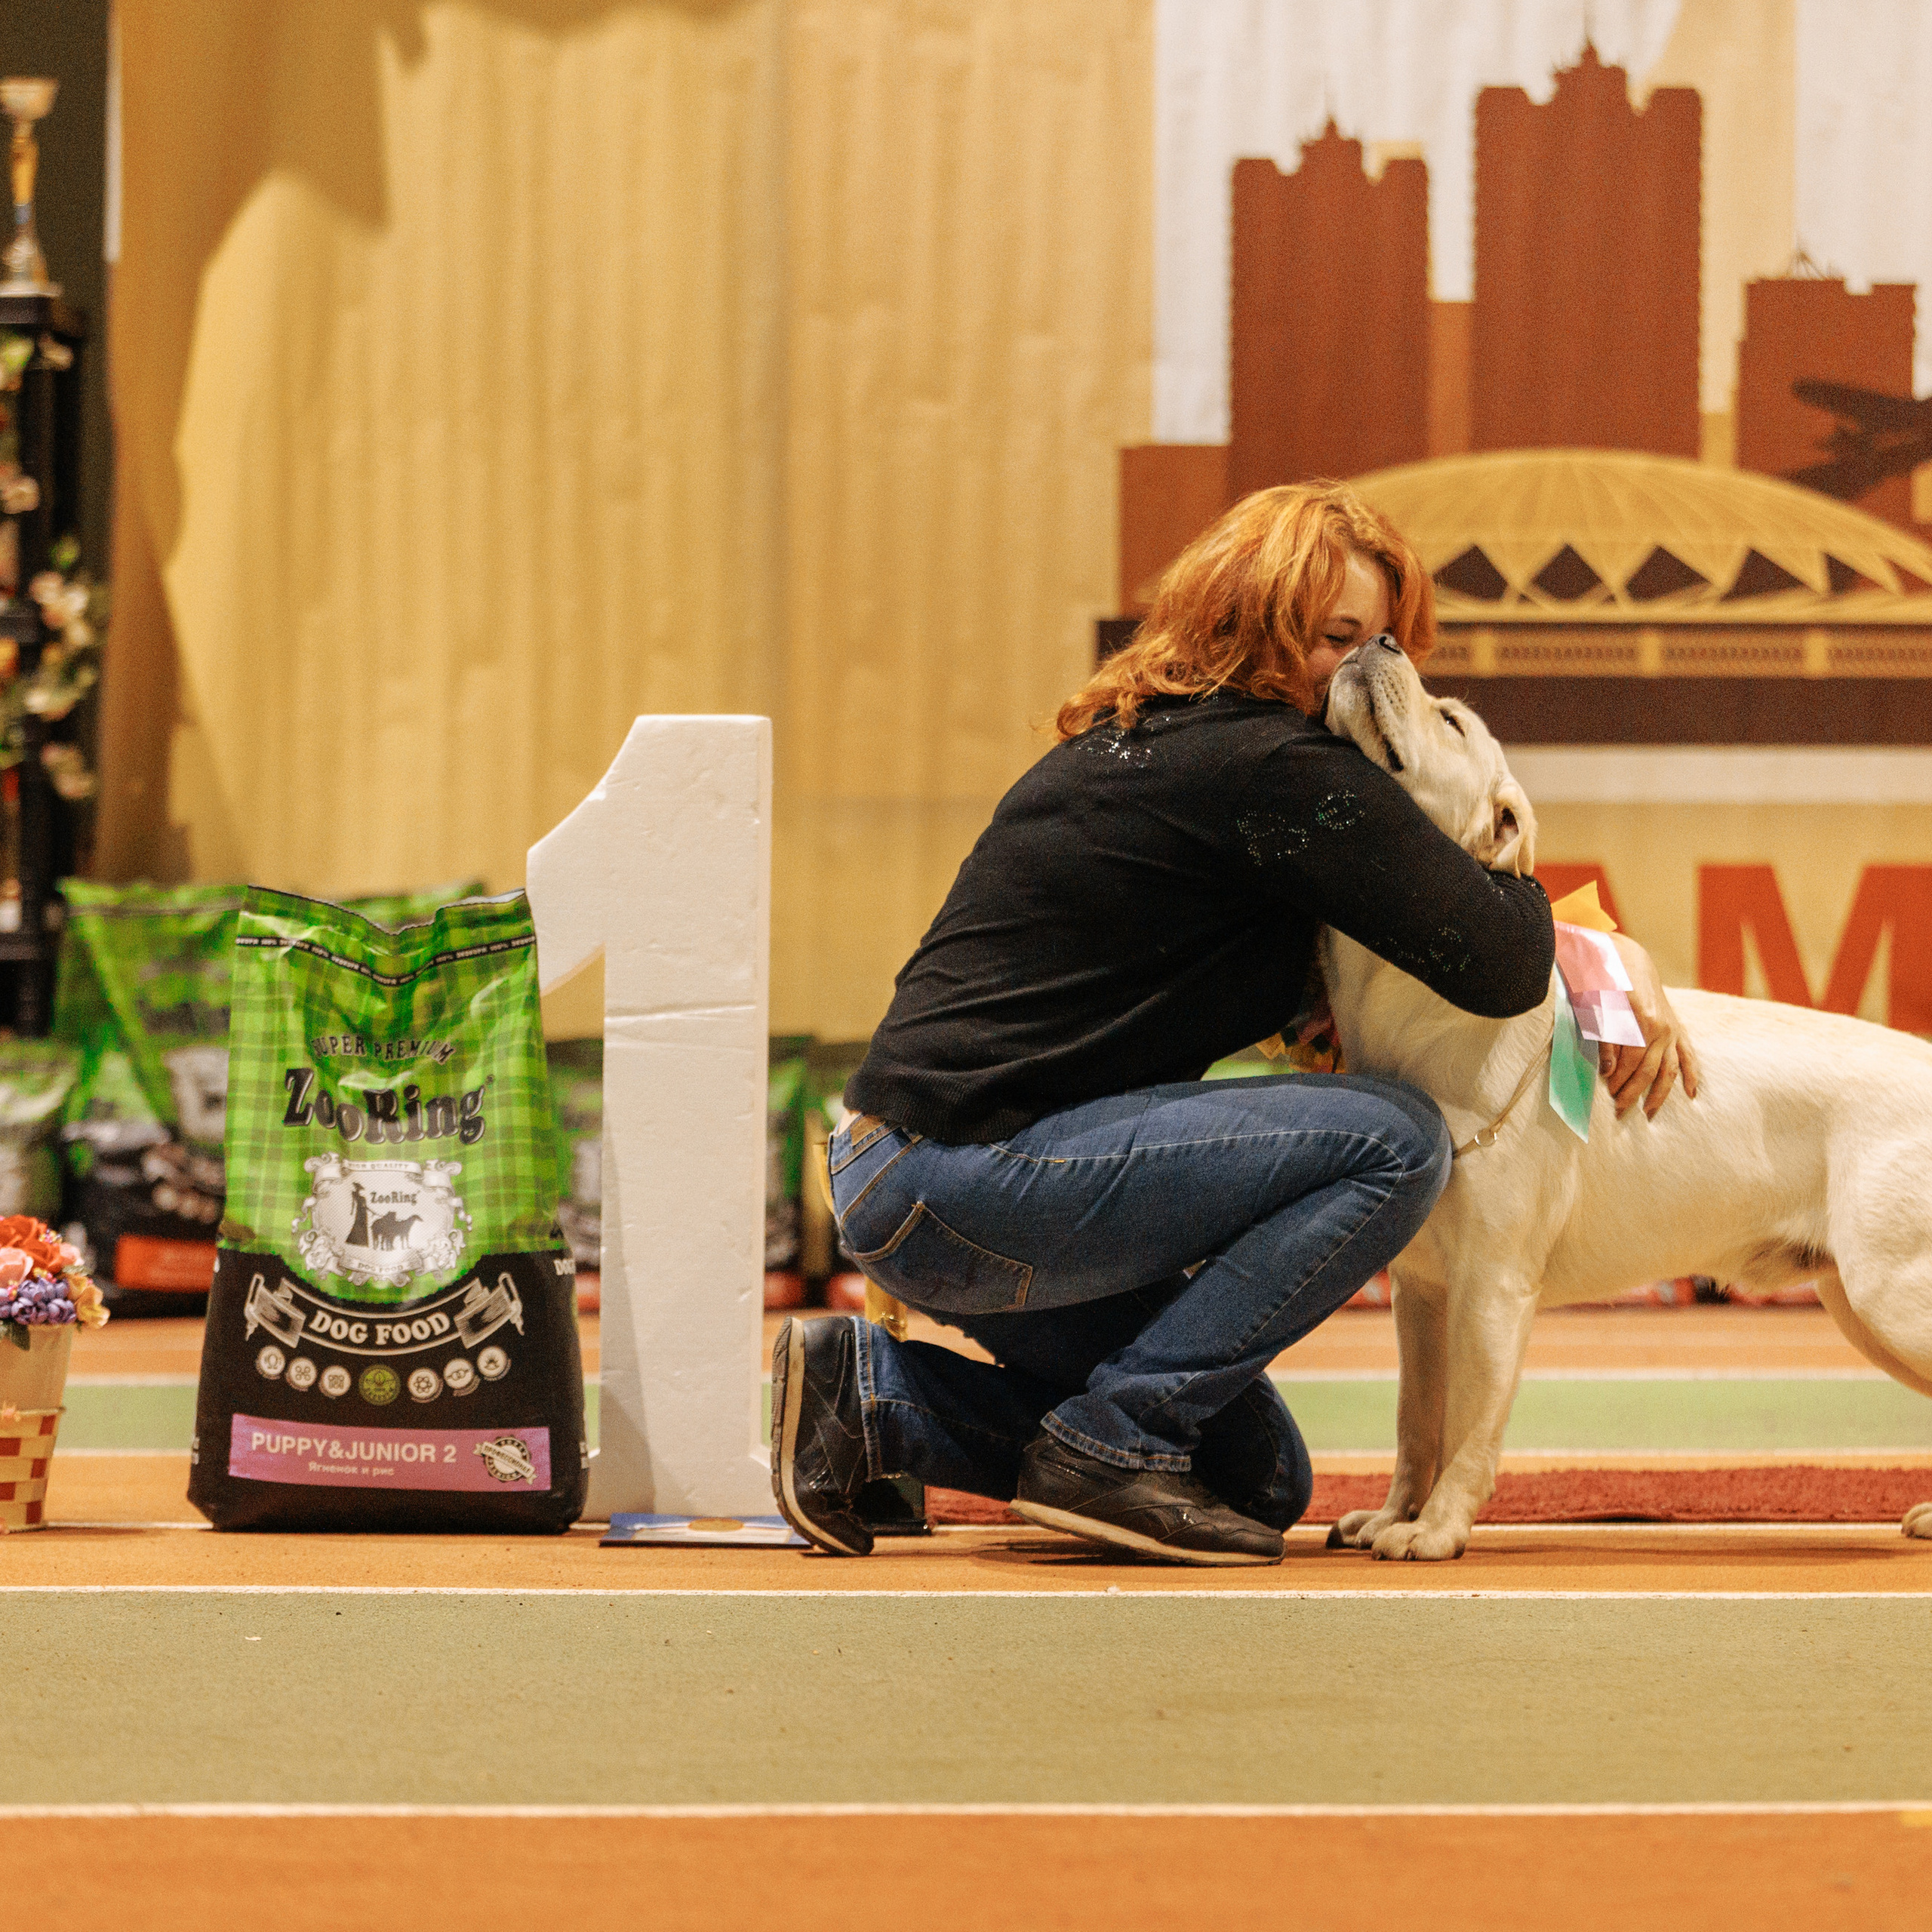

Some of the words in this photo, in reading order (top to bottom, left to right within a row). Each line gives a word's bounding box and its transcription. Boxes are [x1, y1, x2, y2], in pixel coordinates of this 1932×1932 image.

[311, 1035, 367, 1057] SUPER
[374, 1039, 457, 1066] PREMIUM
[282, 1067, 486, 1145] ZooRing
[369, 1190, 417, 1206] ZooRing
[309, 1309, 368, 1344] DOG
[375, 1312, 451, 1346] FOOD
[251, 1432, 436, 1463] PUPPY&JUNIOR
[442, 1444, 457, 1463] 2
[372, 1466, 395, 1478] рис
